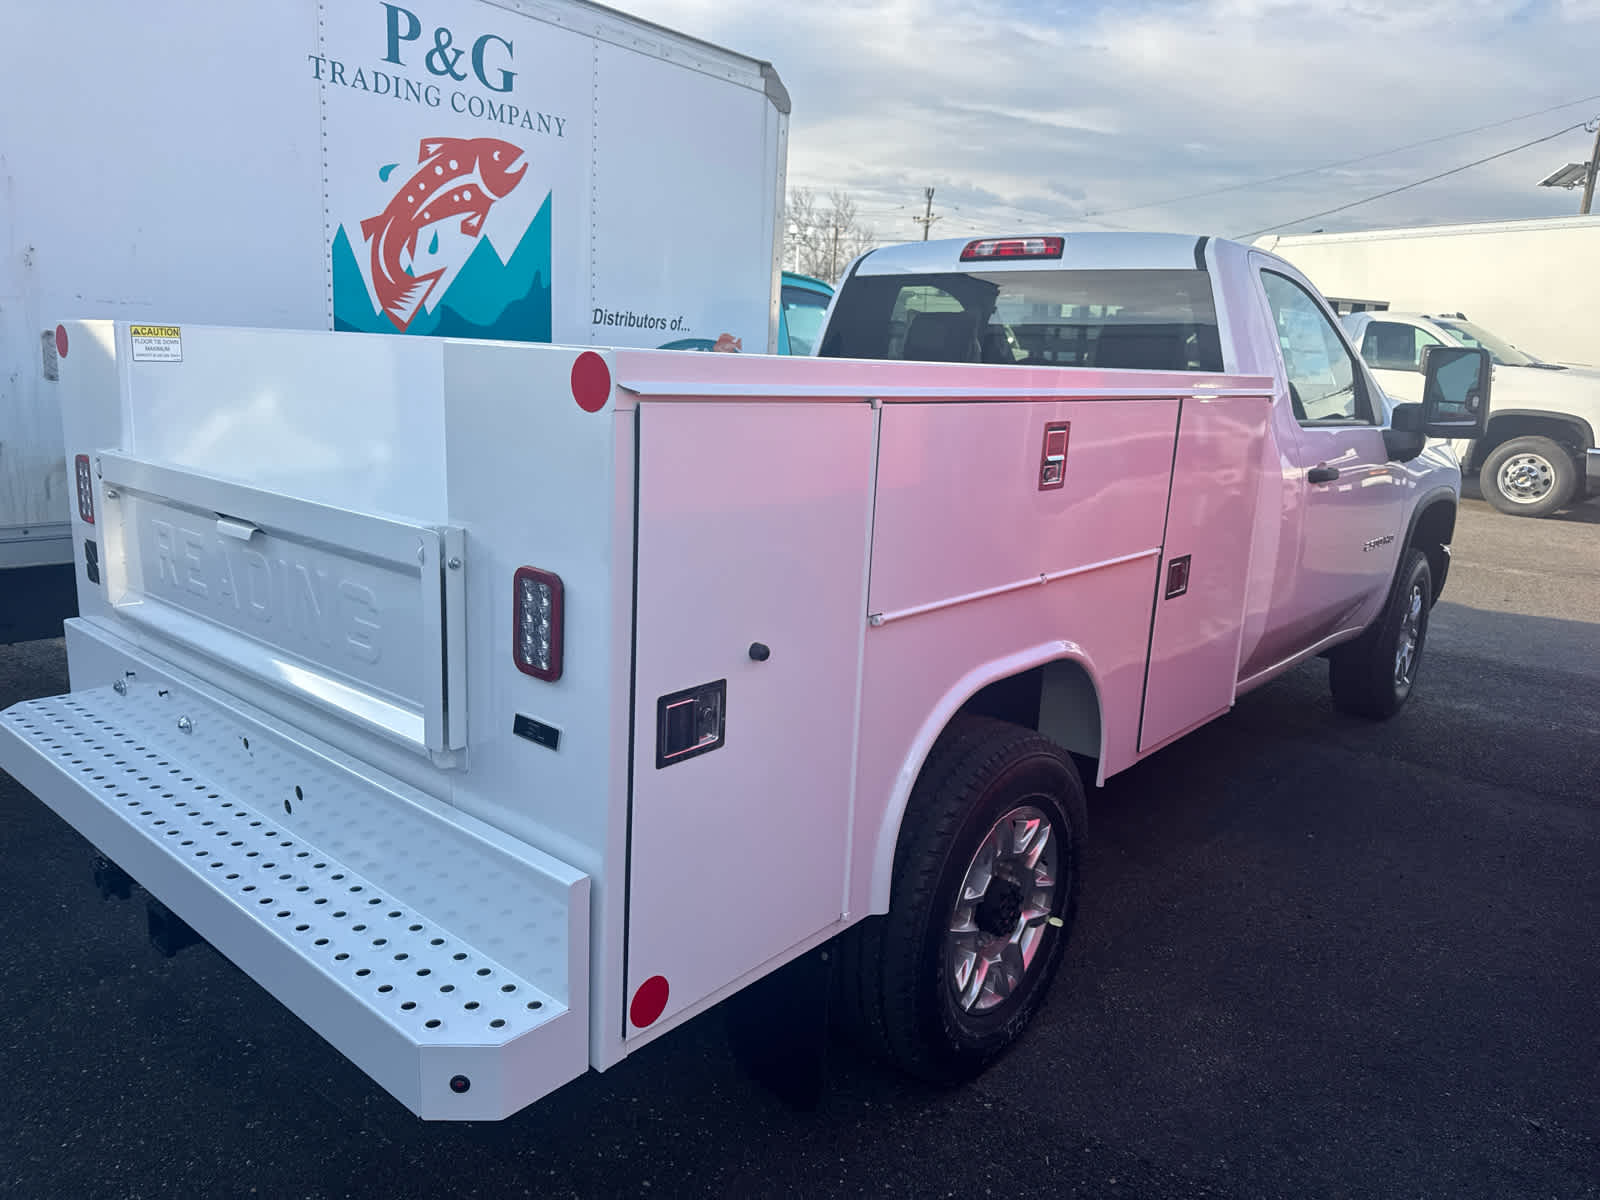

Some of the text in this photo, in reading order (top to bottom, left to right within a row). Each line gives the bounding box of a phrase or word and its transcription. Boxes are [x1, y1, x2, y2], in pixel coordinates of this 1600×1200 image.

[380, 1, 518, 93] P&G
[308, 55, 567, 138] TRADING COMPANY
[140, 327, 179, 337] CAUTION
[593, 308, 691, 332] Distributors of...
[151, 518, 383, 666] READING
